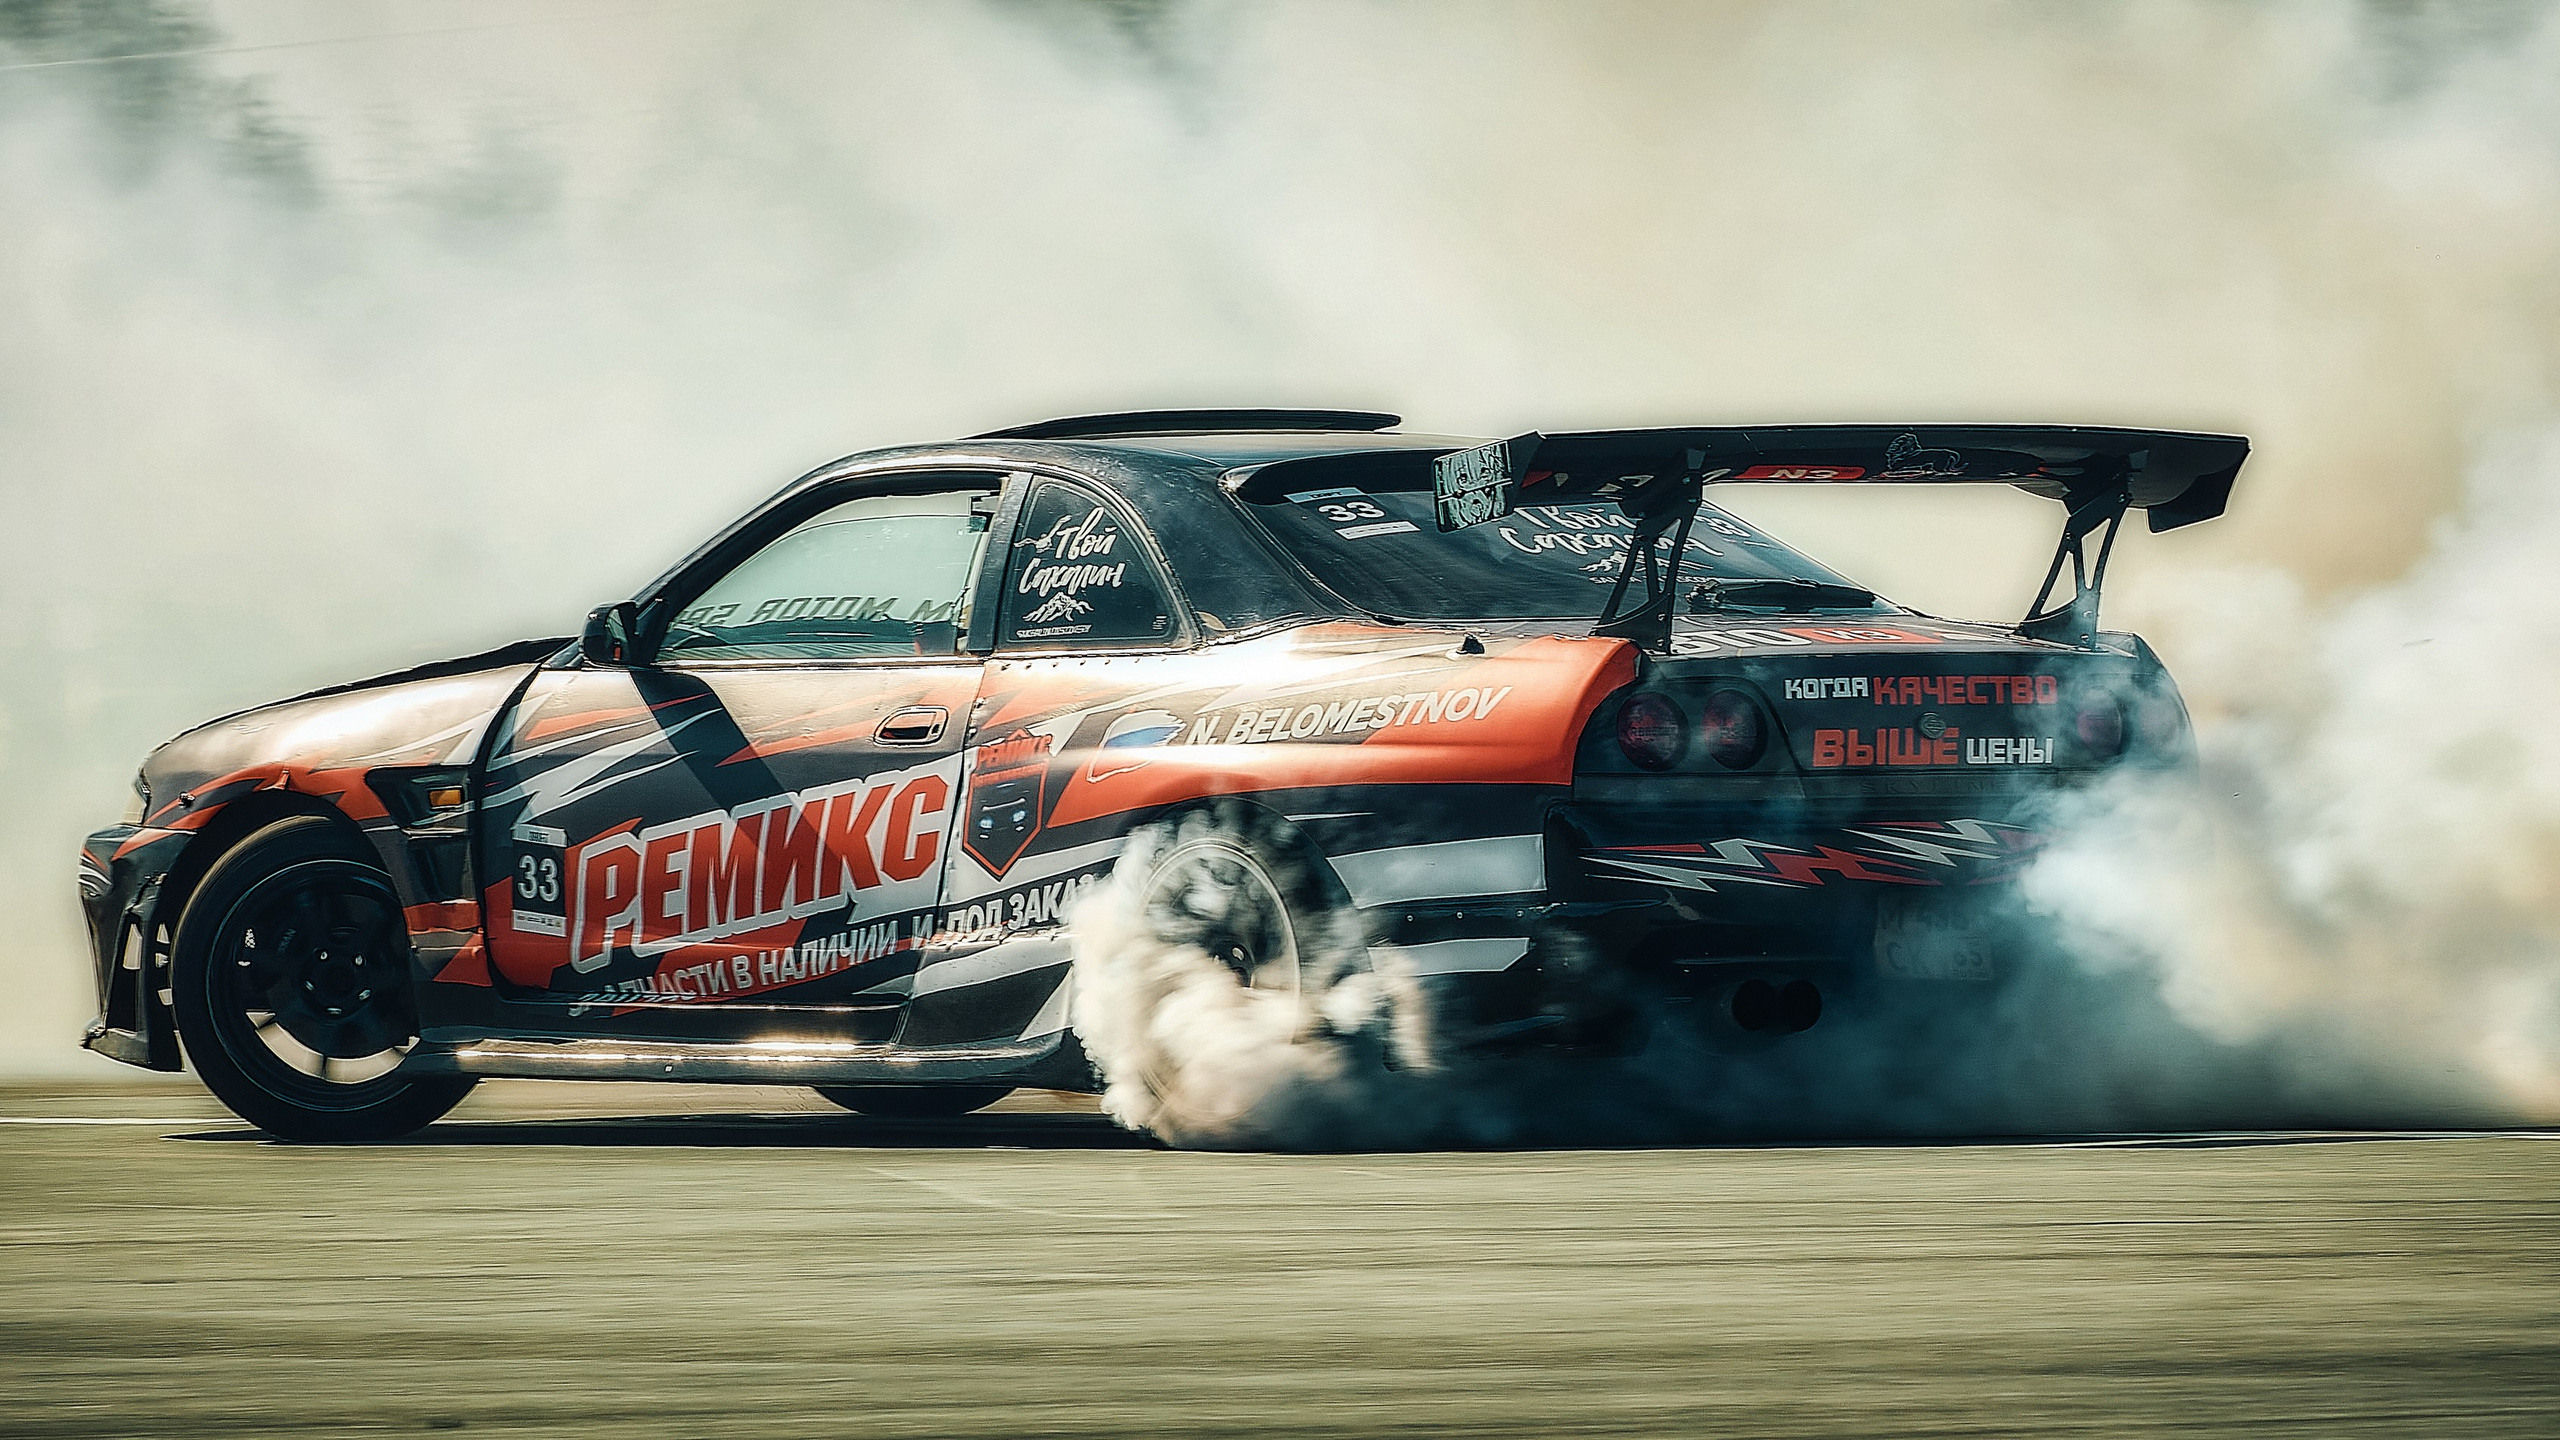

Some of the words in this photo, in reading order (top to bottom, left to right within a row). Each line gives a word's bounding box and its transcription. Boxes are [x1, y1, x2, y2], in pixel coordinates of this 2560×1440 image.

[1055, 507, 1118, 560] Твой
[1318, 501, 1385, 521] 33
[1784, 677, 1869, 700] КОГДА
[1873, 675, 2057, 705] КАЧЕСТВО
[1184, 715, 1222, 745] N.
[1224, 686, 1513, 745] BELOMESTNOV
[1812, 727, 1960, 767] ВЫШЕ
[1965, 737, 2054, 765] ЦЕНЫ
[517, 854, 560, 902] 33
[570, 772, 951, 973] РЕМИКС
[731, 954, 758, 989] В
[758, 920, 899, 985] НАЛИЧИИ
[911, 914, 935, 951] И
